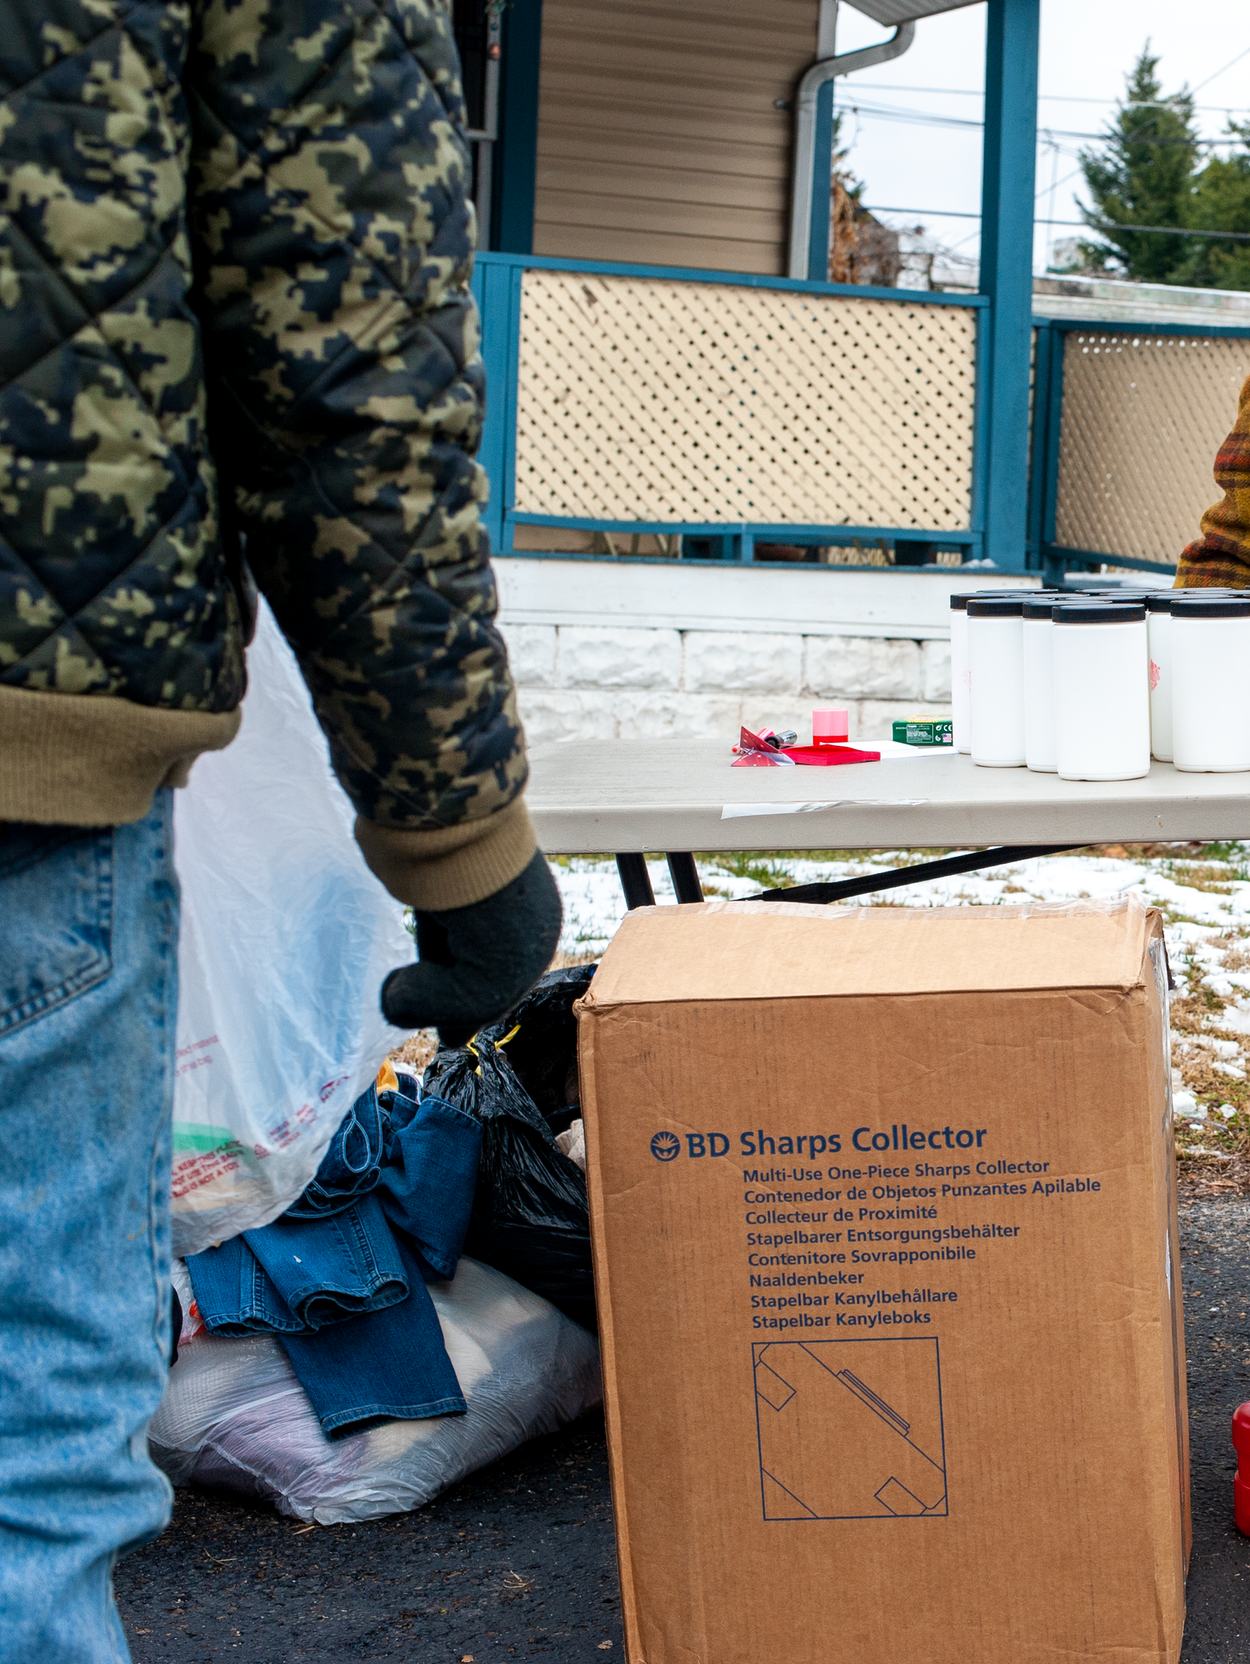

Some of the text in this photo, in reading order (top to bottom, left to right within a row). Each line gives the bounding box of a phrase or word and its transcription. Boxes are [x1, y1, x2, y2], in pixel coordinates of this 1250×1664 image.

[686, 1125, 986, 1159] BD Sharps Collector
[744, 1161, 1049, 1182] Multi-Use One-Piece Sharps Collector
[745, 1178, 1100, 1203] Contenedor de Objetos Punzantes Apilable
[746, 1206, 937, 1224] Collecteur de Proximité
[747, 1224, 1019, 1248] Stapelbarer Entsorgungsbehälter
[749, 1246, 975, 1266] Contenitore Sovrapponibile
[750, 1271, 864, 1286] Naaldenbeker
[751, 1289, 957, 1310] Stapelbar Kanylbehållare
[753, 1310, 930, 1330] Stapelbar Kanyleboks
